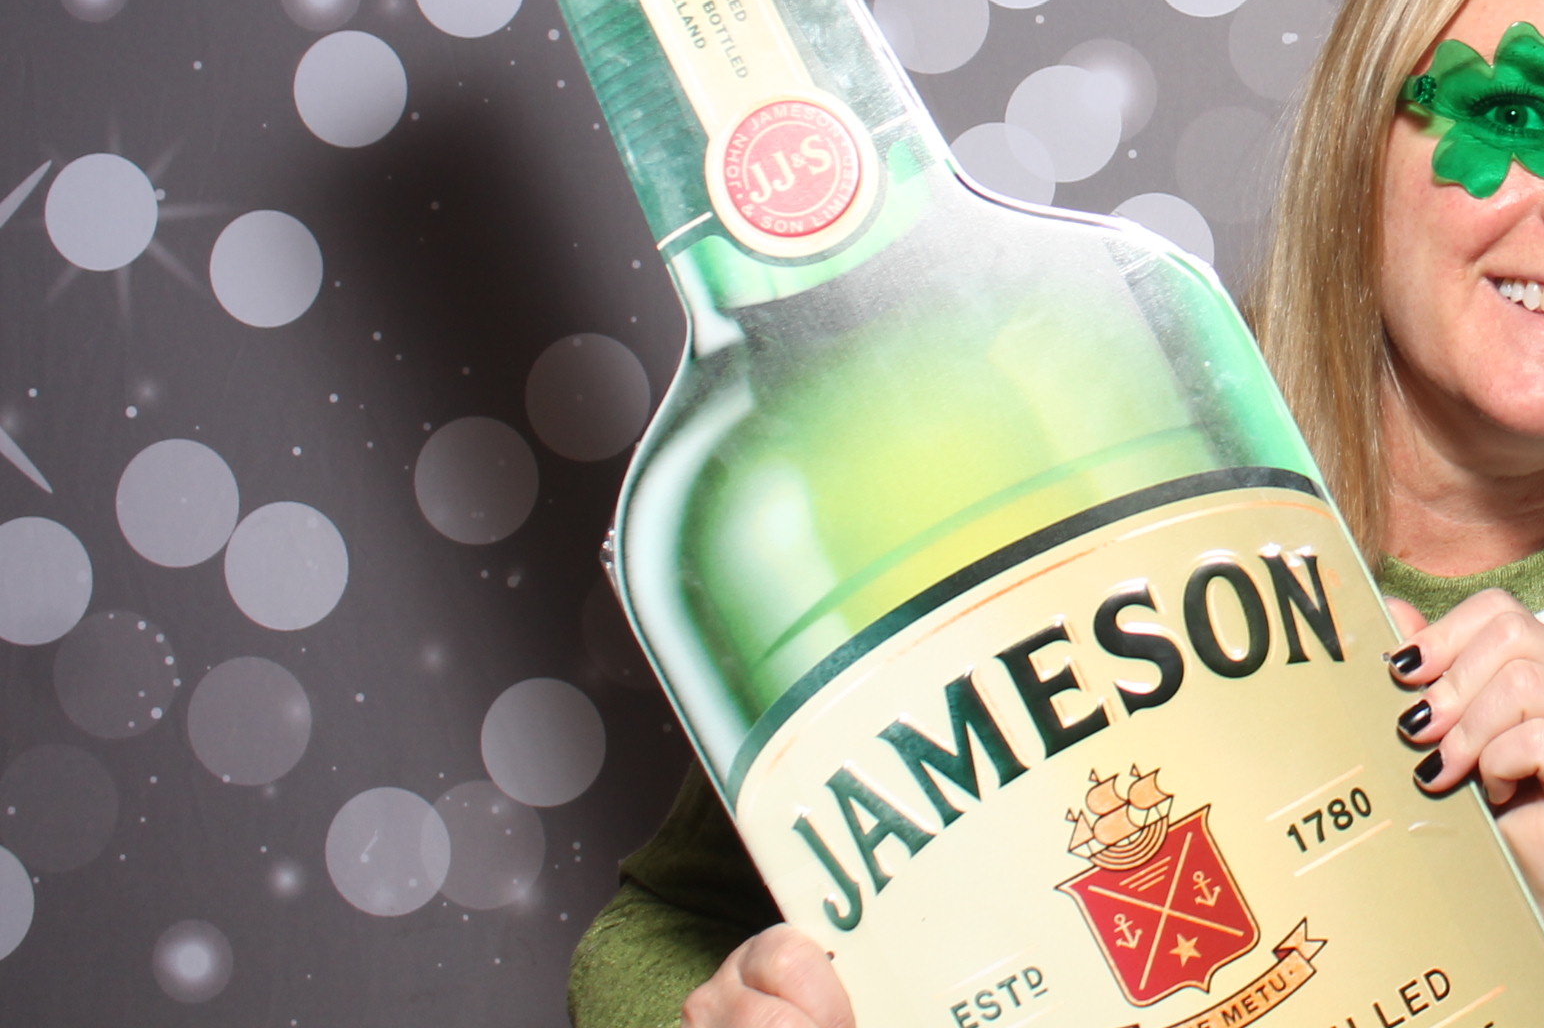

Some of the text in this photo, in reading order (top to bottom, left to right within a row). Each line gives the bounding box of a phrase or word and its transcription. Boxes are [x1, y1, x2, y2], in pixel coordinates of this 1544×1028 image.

[702, 0, 749, 79] BOTTLED
[725, 104, 842, 189] JOHN JAMESON
[760, 215, 804, 233] SON
[810, 154, 853, 227] LIMITED
[791, 549, 1347, 932] JAMESON
[1286, 786, 1372, 853] 1780
